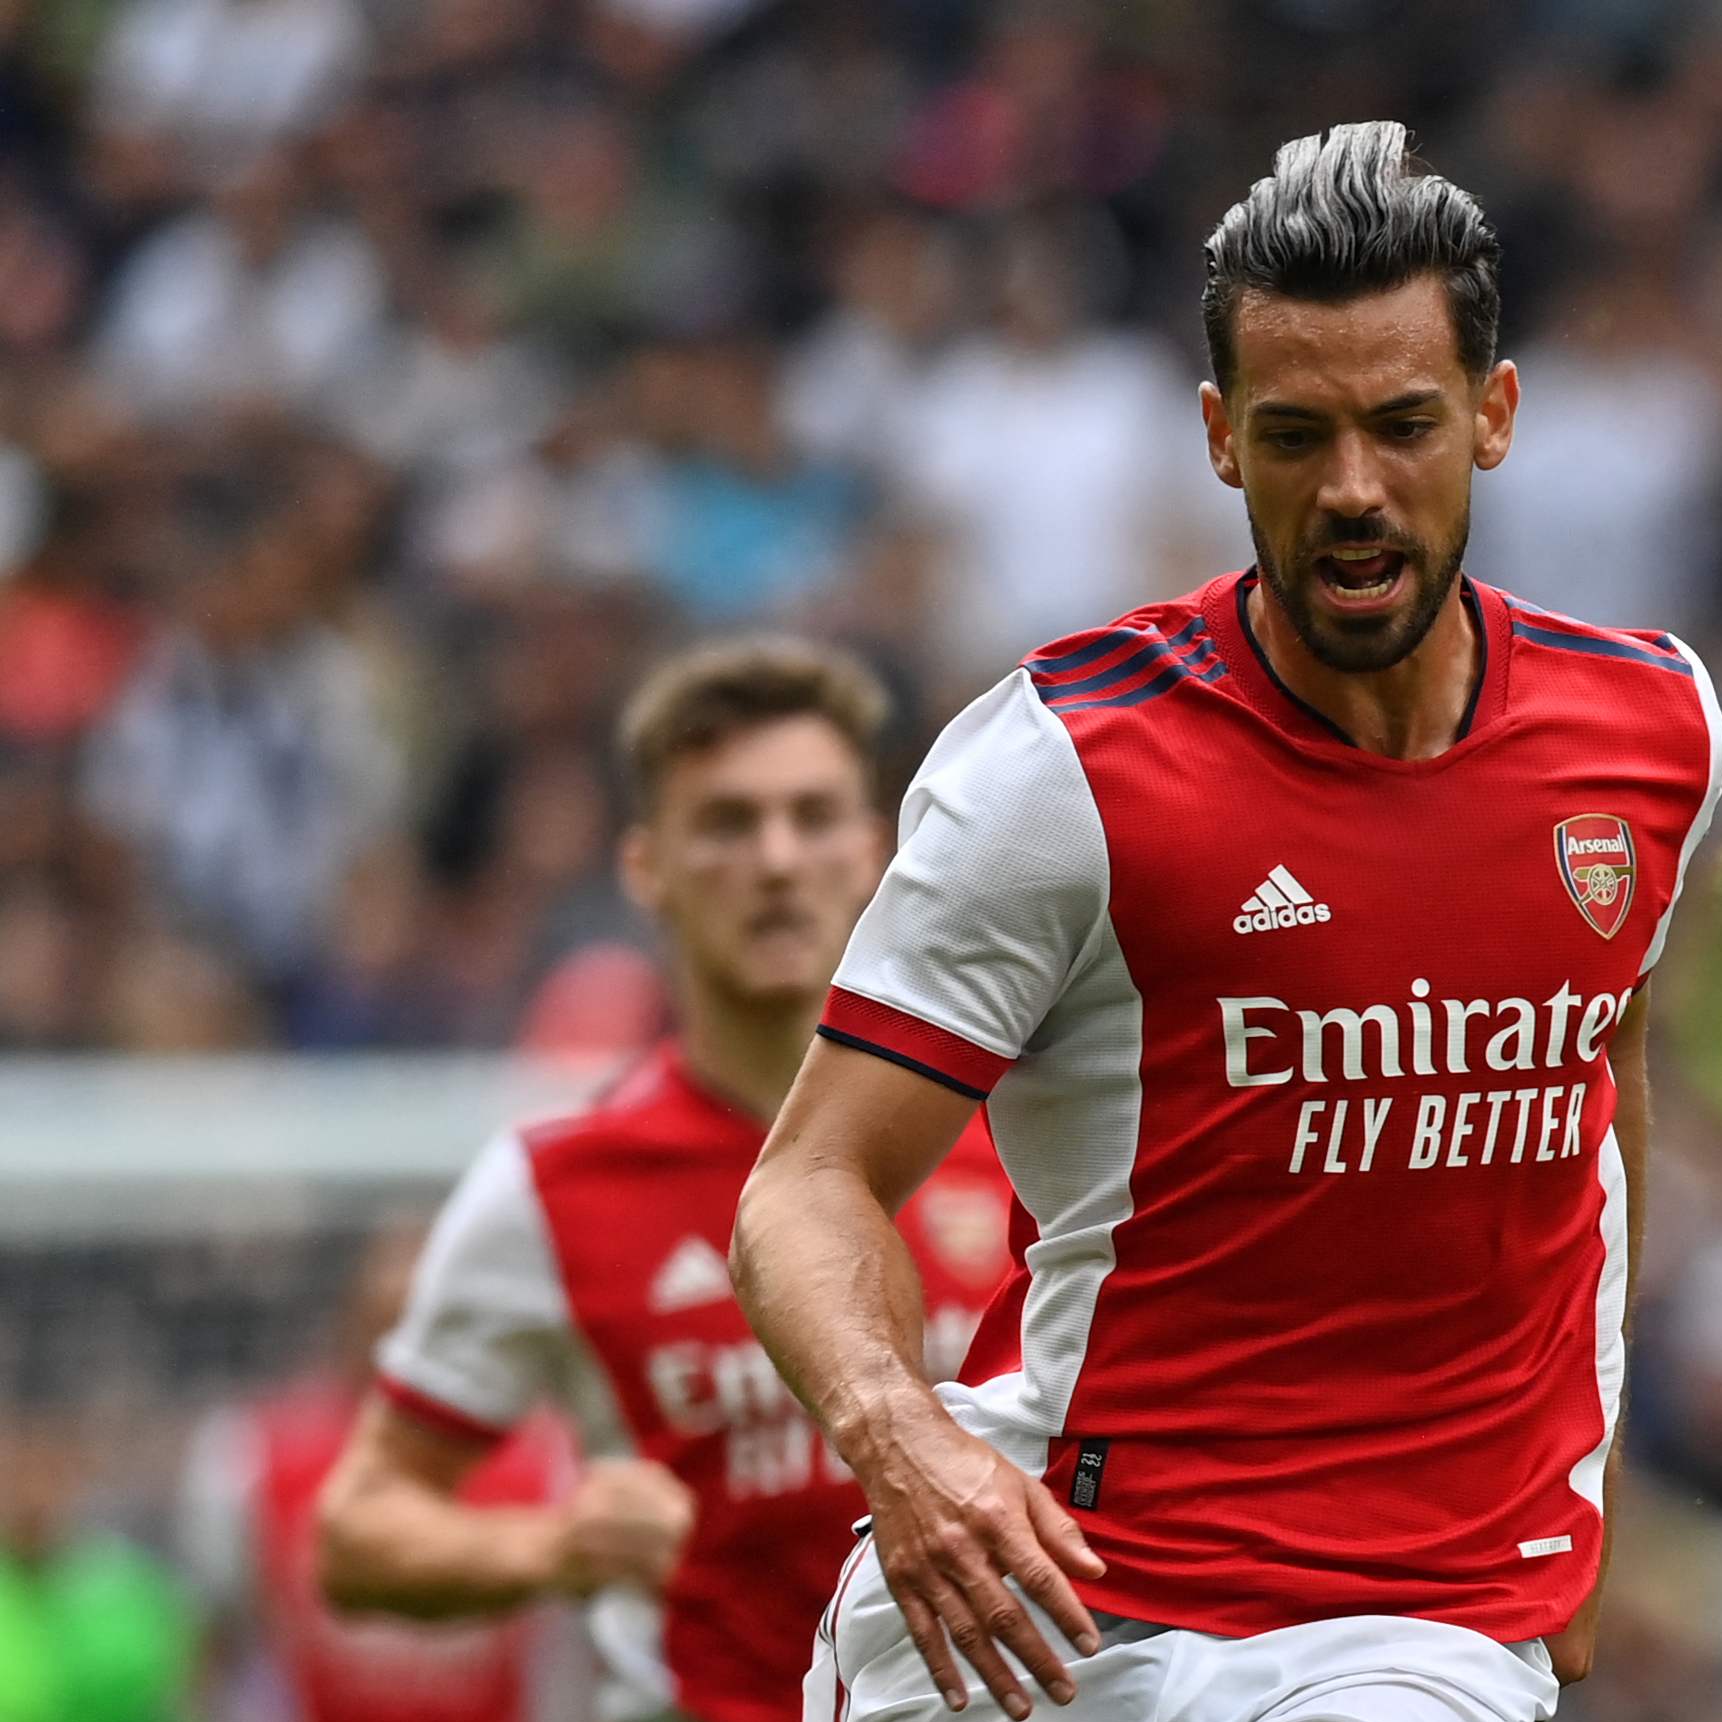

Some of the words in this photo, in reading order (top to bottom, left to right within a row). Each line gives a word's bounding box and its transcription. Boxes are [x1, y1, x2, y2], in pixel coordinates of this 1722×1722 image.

[1567, 834, 1624, 856] Arsenal
[1233, 899, 1331, 934] adidas
[1289, 1098, 1393, 1174] FLY
[1408, 1083, 1587, 1170] BETTER
